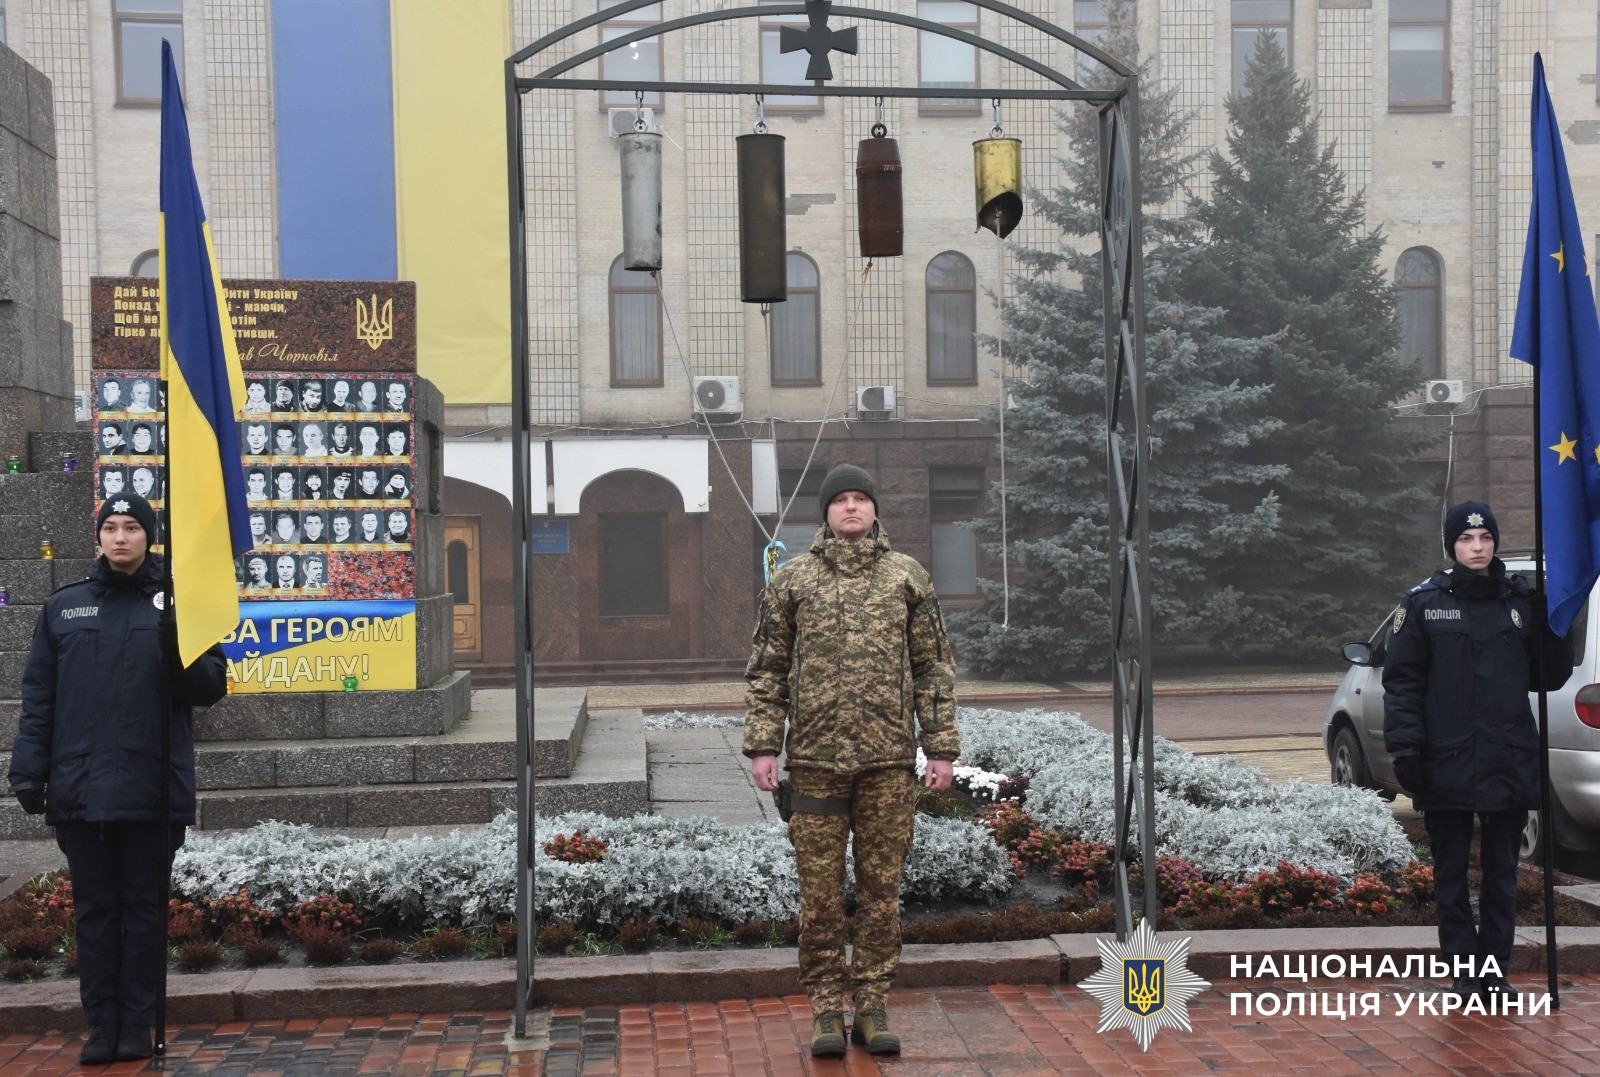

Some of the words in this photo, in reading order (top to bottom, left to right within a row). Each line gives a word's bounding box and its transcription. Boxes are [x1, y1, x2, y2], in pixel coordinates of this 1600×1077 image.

[114, 285, 137, 299] Дай
[254, 289, 298, 300] Україну
[114, 299, 152, 312] Понад
[244, 303, 288, 314] маючи,
[114, 312, 140, 325] Щоб
[144, 315, 159, 324] не
[114, 326, 146, 338] Гірко
[258, 343, 340, 362] Чорновіл
[61, 606, 99, 620] ПОЛІЦІЯ
[1424, 608, 1461, 621] ПОЛІЦІЯ
[270, 616, 404, 643] ГЕРОЯМ
